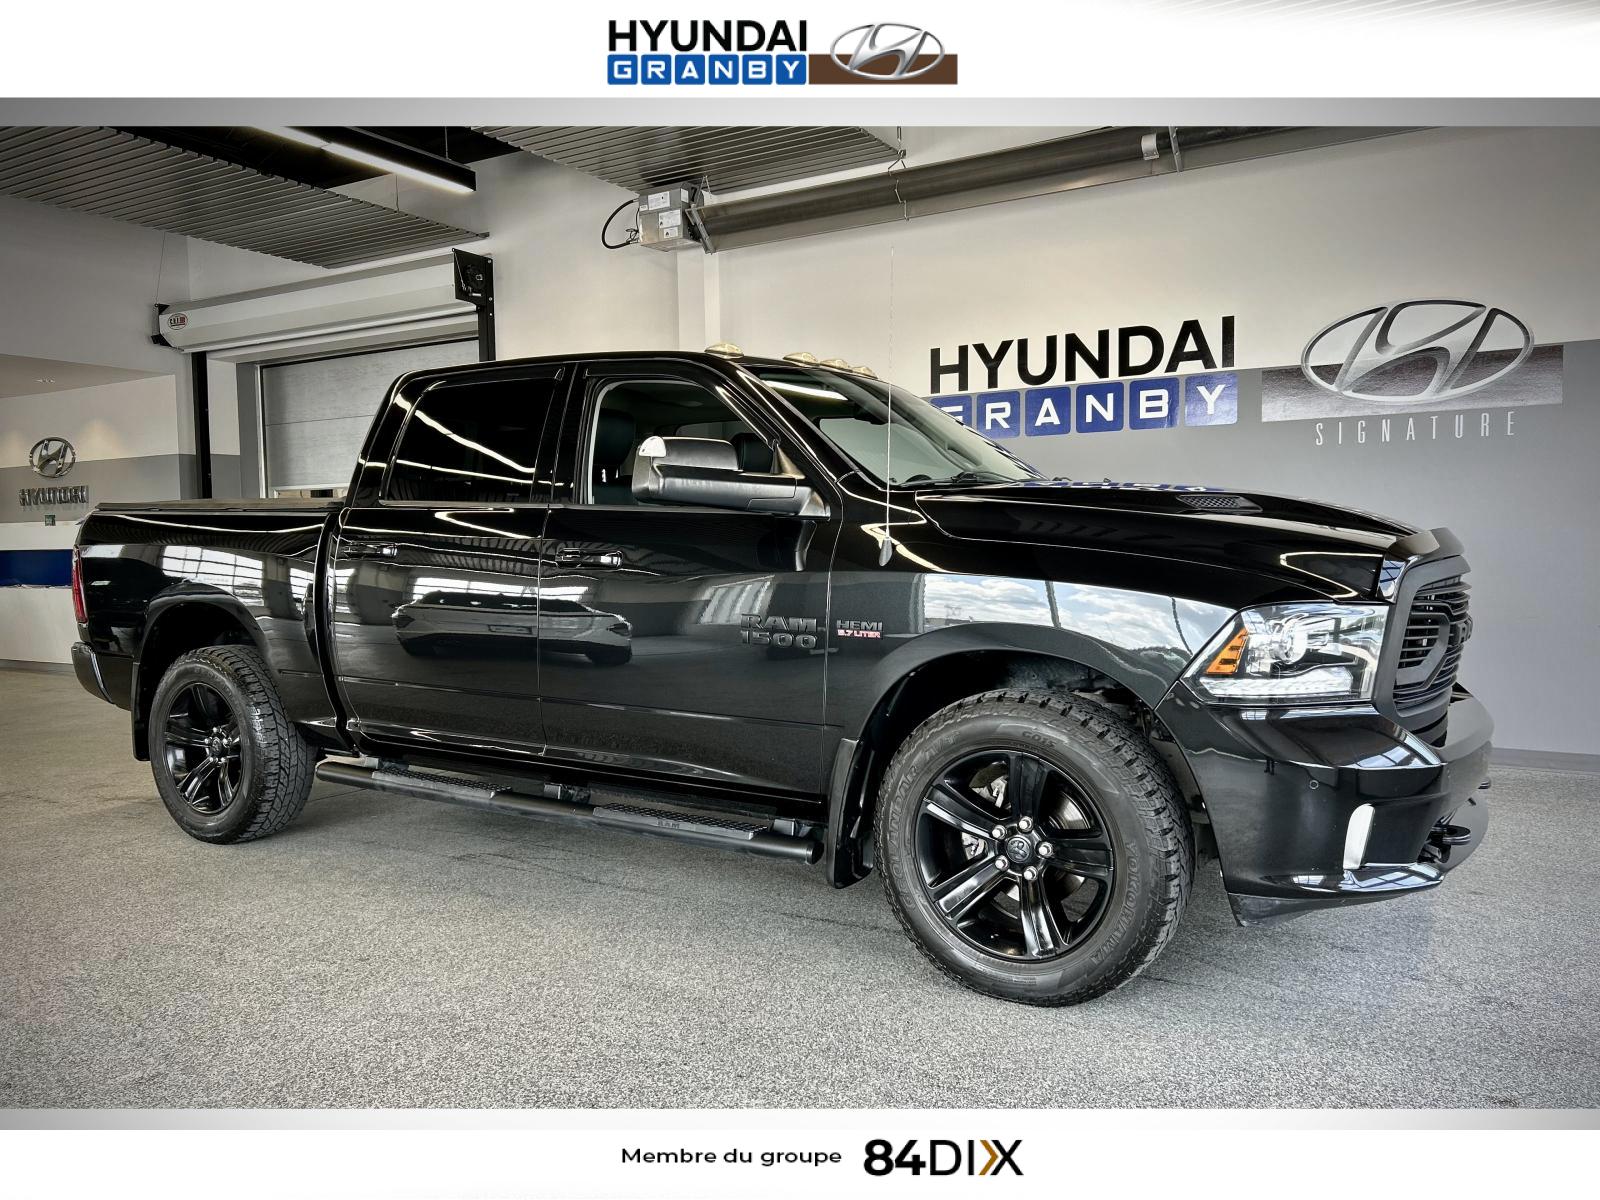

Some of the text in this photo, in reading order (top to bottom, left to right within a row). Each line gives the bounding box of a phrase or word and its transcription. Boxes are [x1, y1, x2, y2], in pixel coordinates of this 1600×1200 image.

[930, 315, 1235, 395] HYUNDAI
[1315, 411, 1518, 447] SIGNATURE
[741, 613, 818, 633] RAM
[836, 619, 883, 631] HEMI
[740, 630, 819, 649] 1500
[853, 630, 881, 639] LITER
[1089, 841, 1140, 966] YOKOHAMA
